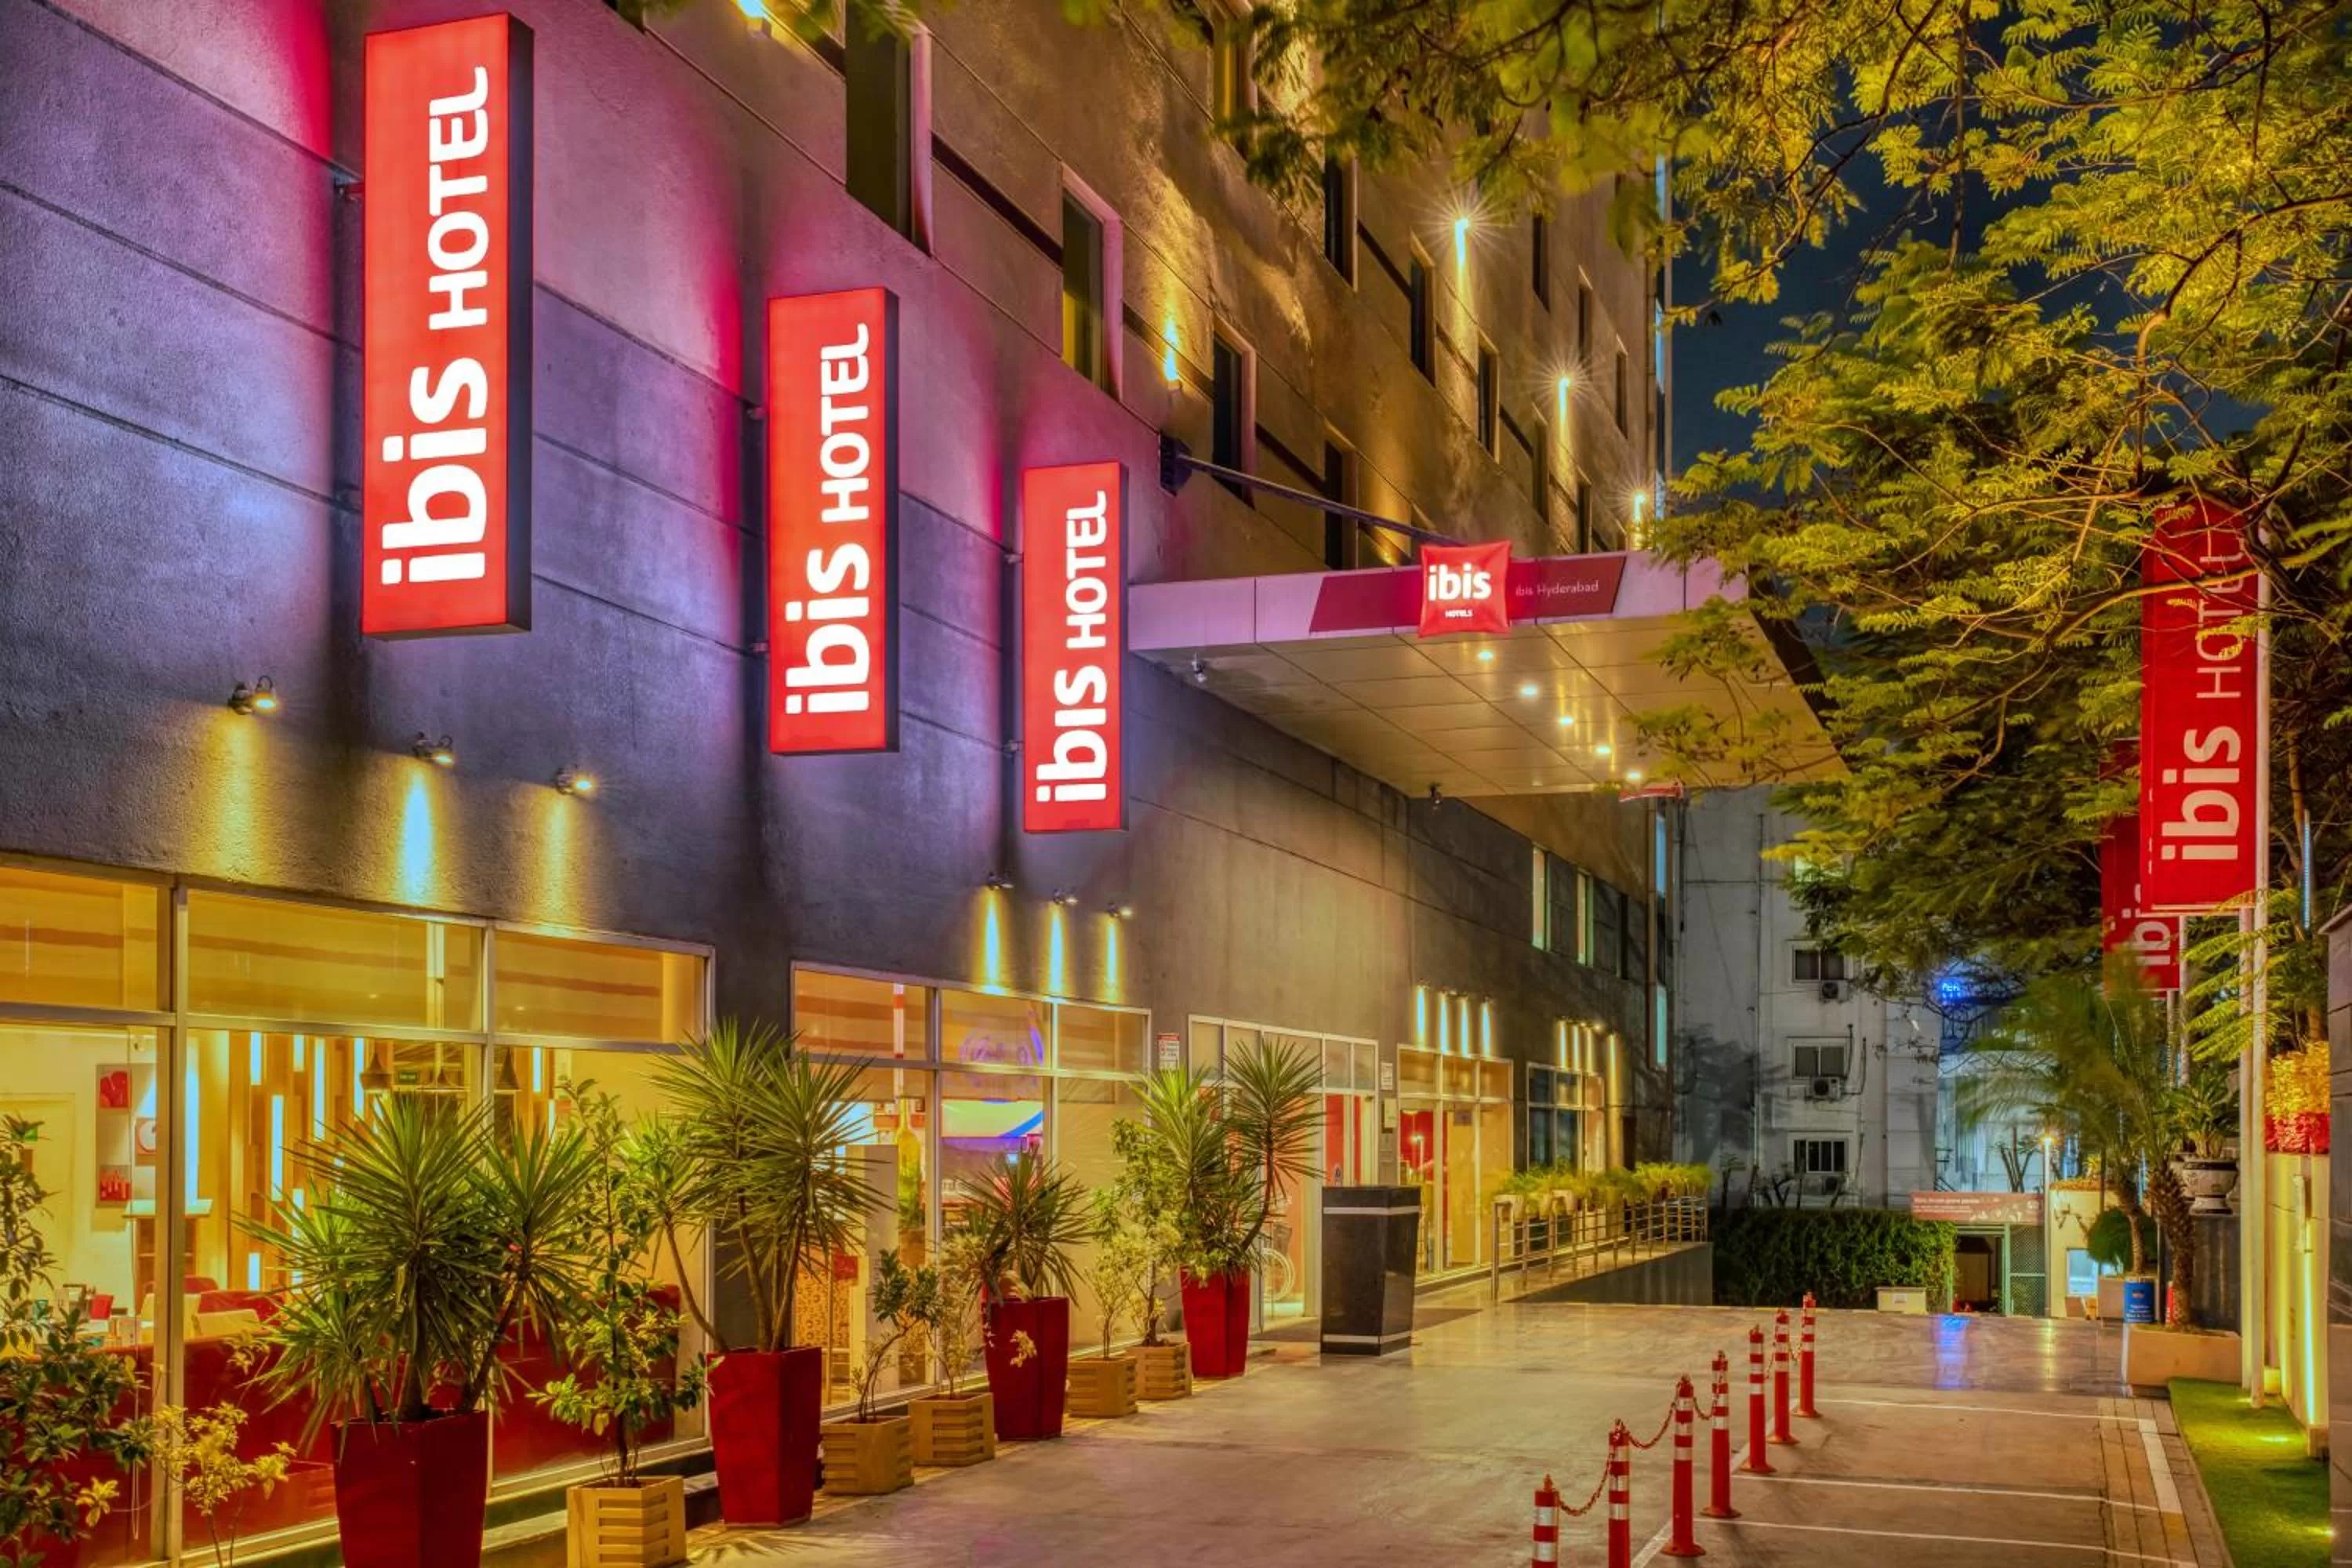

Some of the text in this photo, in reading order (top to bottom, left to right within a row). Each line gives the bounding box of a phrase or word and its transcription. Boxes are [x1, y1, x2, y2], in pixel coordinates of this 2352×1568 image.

[382, 67, 489, 585] ibis HOTEL
[786, 323, 870, 714] ibis HOTEL
[1428, 562, 1492, 601] ibis
[1036, 491, 1108, 803] ibis HOTEL
[1445, 608, 1473, 619] HOTELS
[1515, 580, 1599, 598] ibis Hyderabad
[2161, 726, 2241, 862] ibis
